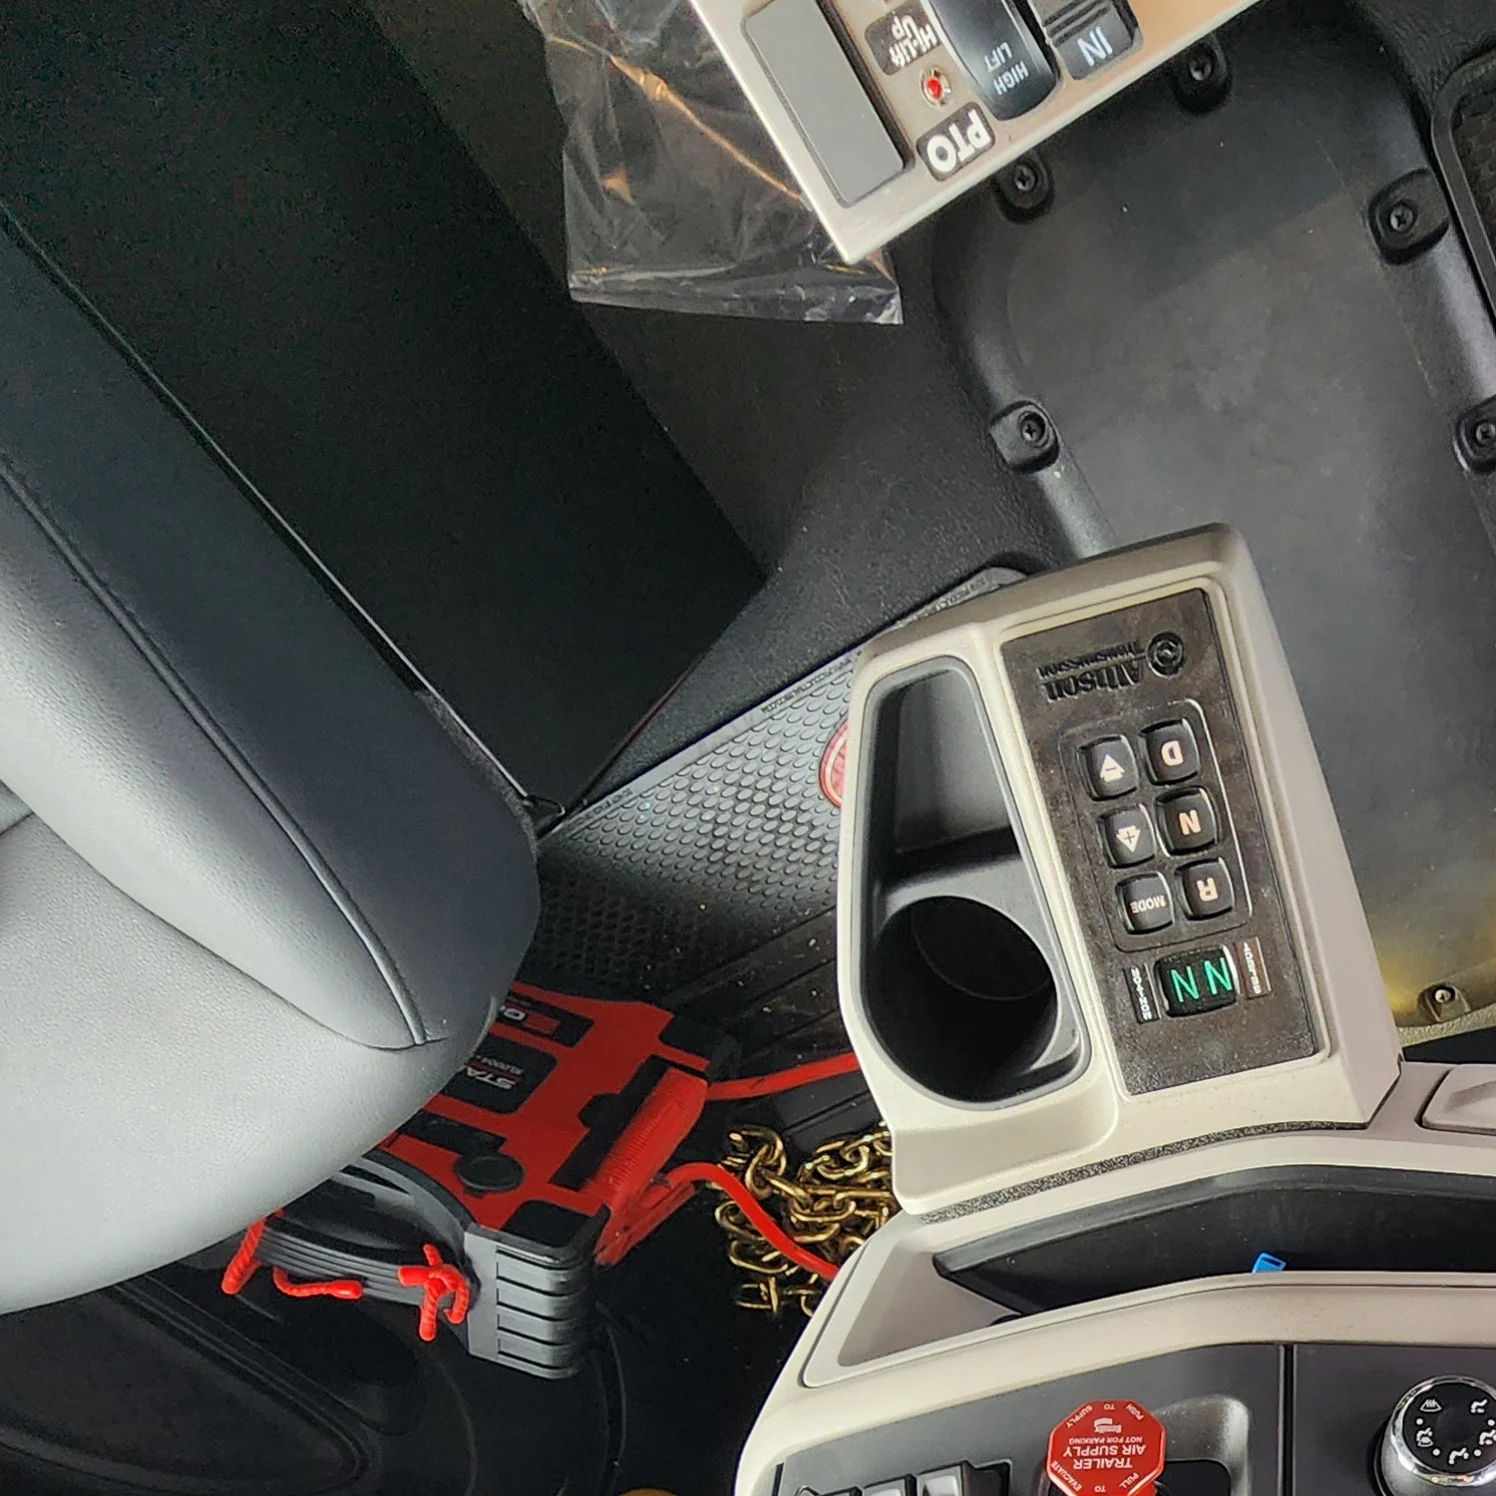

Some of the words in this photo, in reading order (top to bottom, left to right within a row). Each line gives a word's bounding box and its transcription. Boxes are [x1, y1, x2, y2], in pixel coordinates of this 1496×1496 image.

[890, 10, 921, 40] Up
[888, 23, 938, 68] Hi-Lift
[983, 41, 1012, 73] LIFT
[1076, 25, 1114, 67] IN
[993, 60, 1029, 95] HIGH
[927, 108, 991, 173] PTO
[1161, 740, 1184, 766] D
[1178, 809, 1202, 836] N
[1196, 877, 1218, 902] R
[1129, 894, 1167, 914] MODE
[1065, 1404, 1093, 1428] SUPPLY
[1125, 1404, 1144, 1421] PUSH
[1062, 1445, 1119, 1457] SUPPLY
[1069, 1437, 1106, 1445] PARKING
[1106, 1436, 1124, 1444] FOR
[1122, 1444, 1146, 1455] AIR
[1050, 1460, 1083, 1491] EVACUATE
[1072, 1457, 1133, 1470] TRAILER
[1093, 1485, 1106, 1493] TO
[1118, 1472, 1139, 1488] PULL
